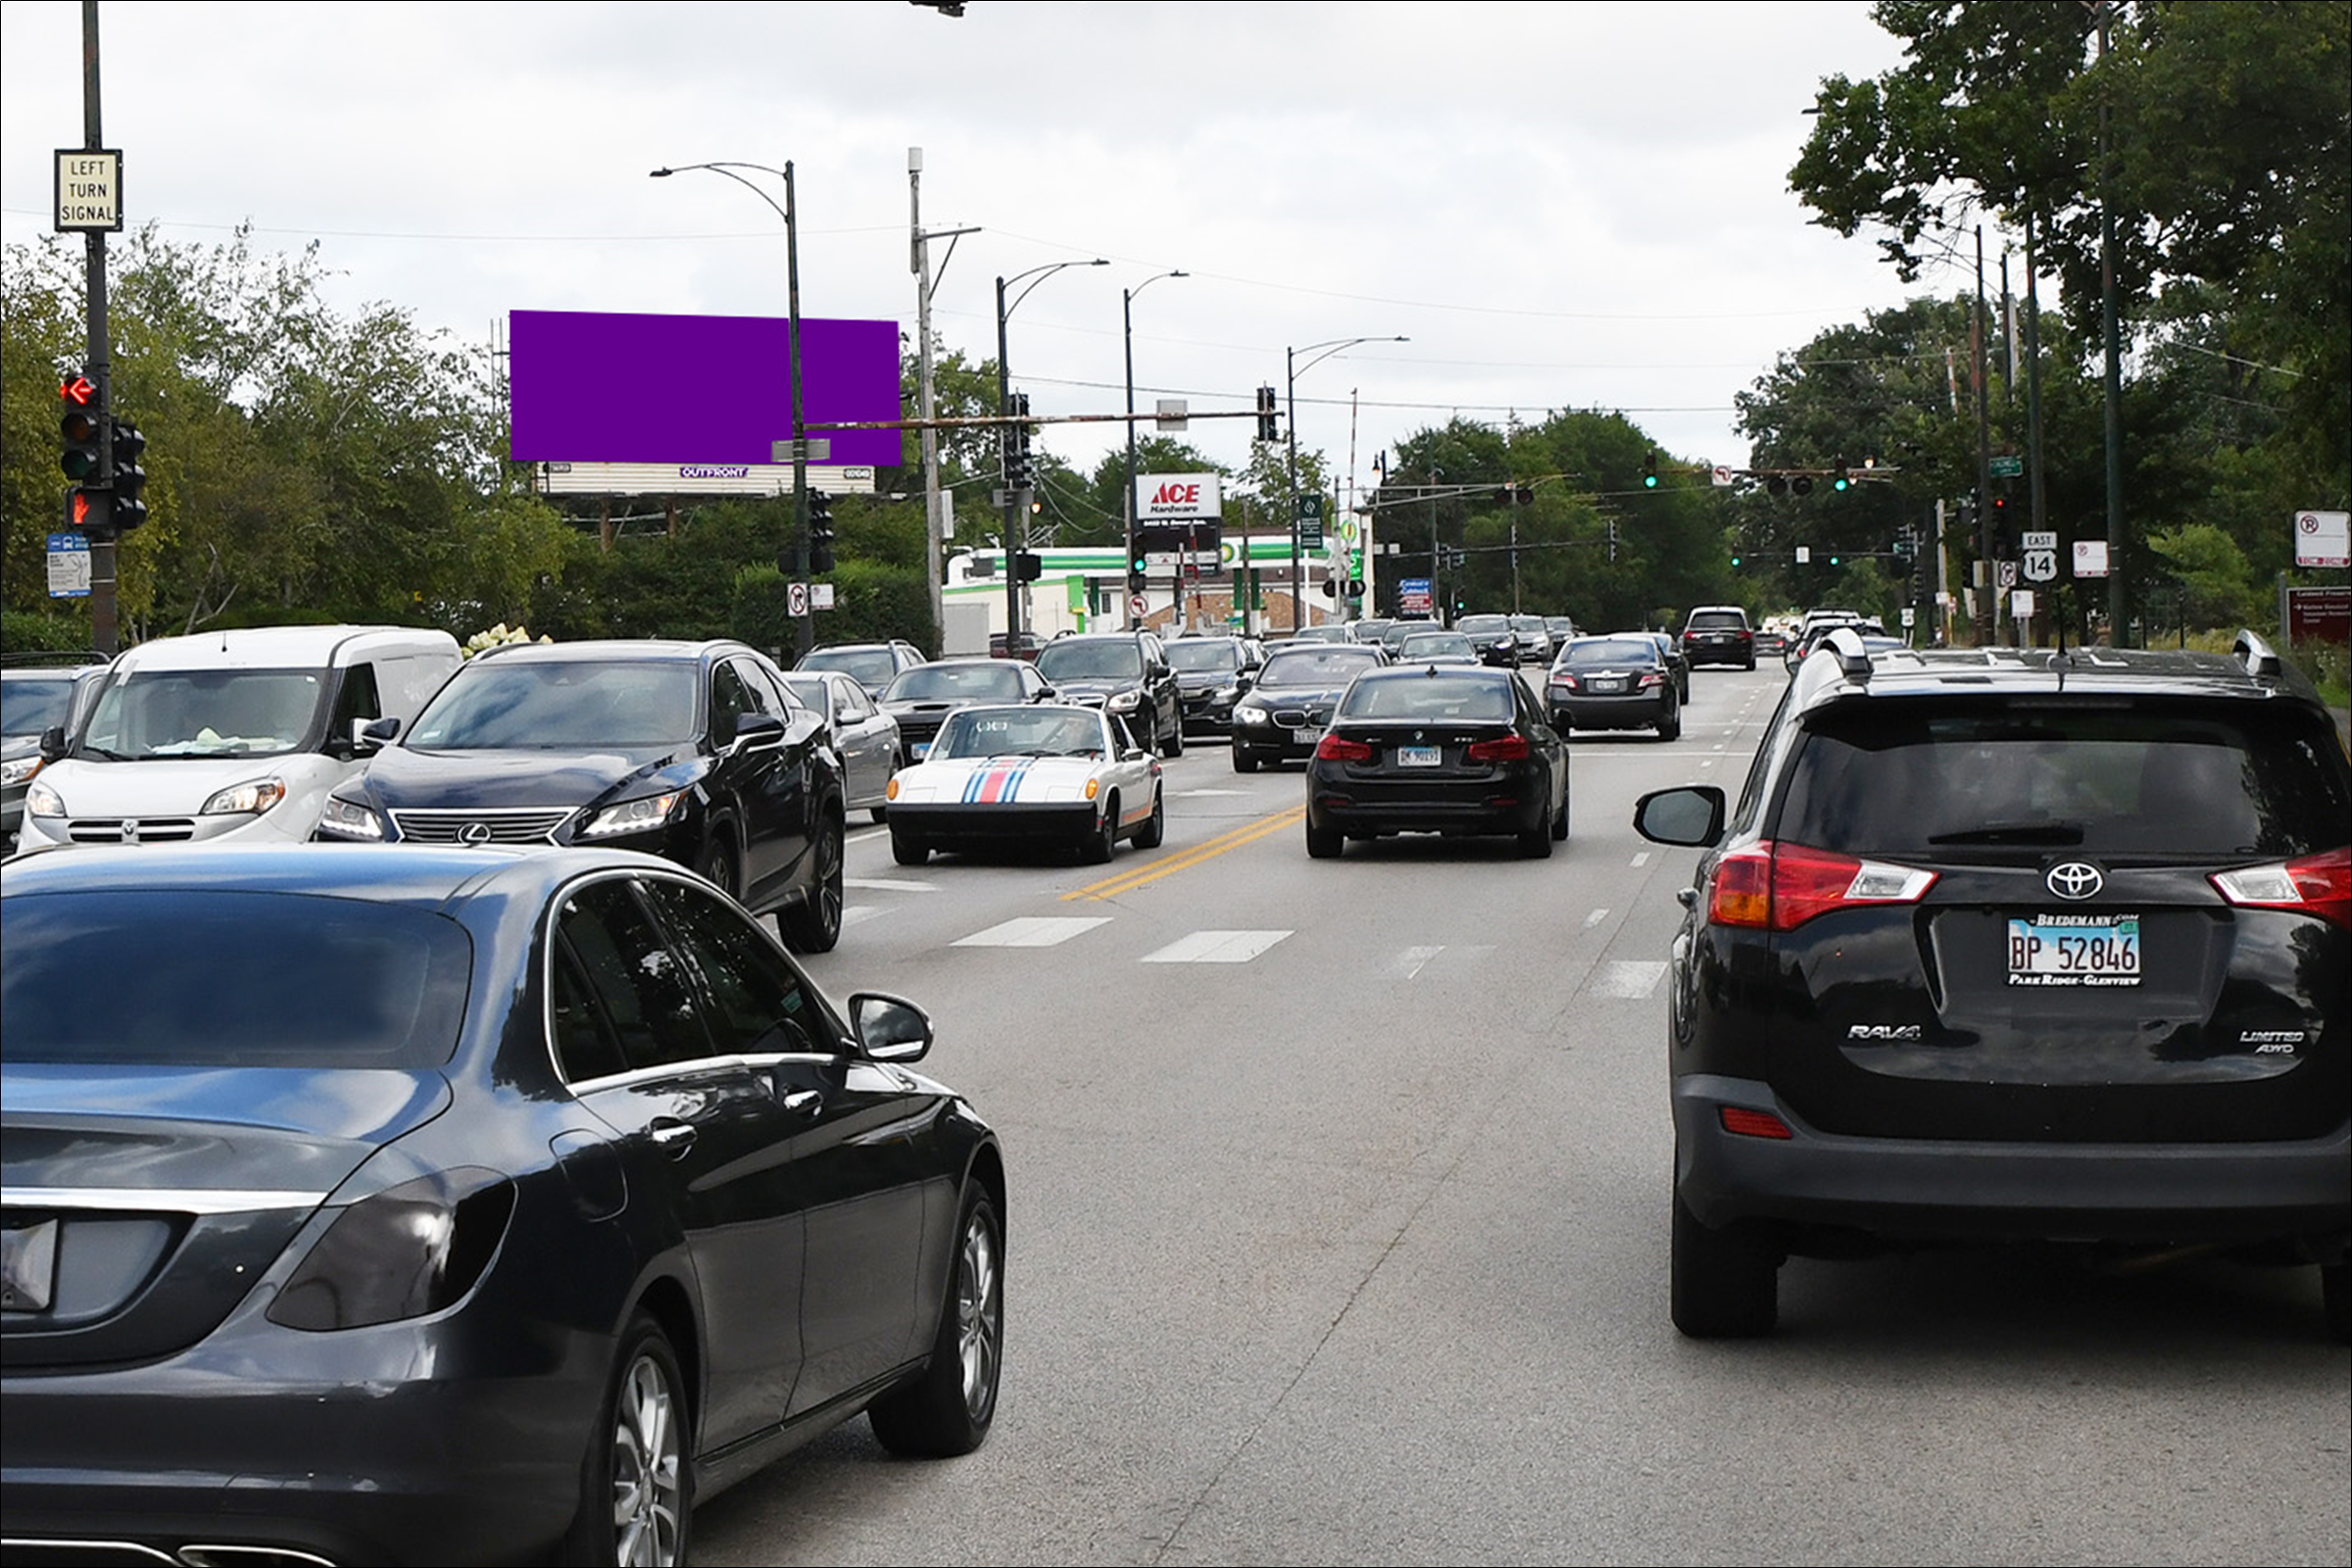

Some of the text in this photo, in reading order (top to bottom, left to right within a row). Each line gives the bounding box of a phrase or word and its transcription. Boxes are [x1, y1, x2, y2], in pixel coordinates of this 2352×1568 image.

[71, 161, 105, 175] LEFT
[69, 183, 107, 198] TURN
[62, 206, 115, 220] SIGNAL
[682, 466, 746, 478] OUTFRONT
[1151, 481, 1200, 504] ACE
[1150, 505, 1199, 514] Hardware
[2028, 535, 2051, 546] EAST
[2030, 556, 2051, 575] 14
[2036, 913, 2112, 926] BREDEMANN
[2011, 936, 2135, 970] BP 52846
[2009, 974, 2040, 985] PARK
[1847, 1025, 1921, 1040] RAV4
[2239, 1031, 2304, 1042] LIMITED
[2255, 1044, 2294, 1054] AWD
